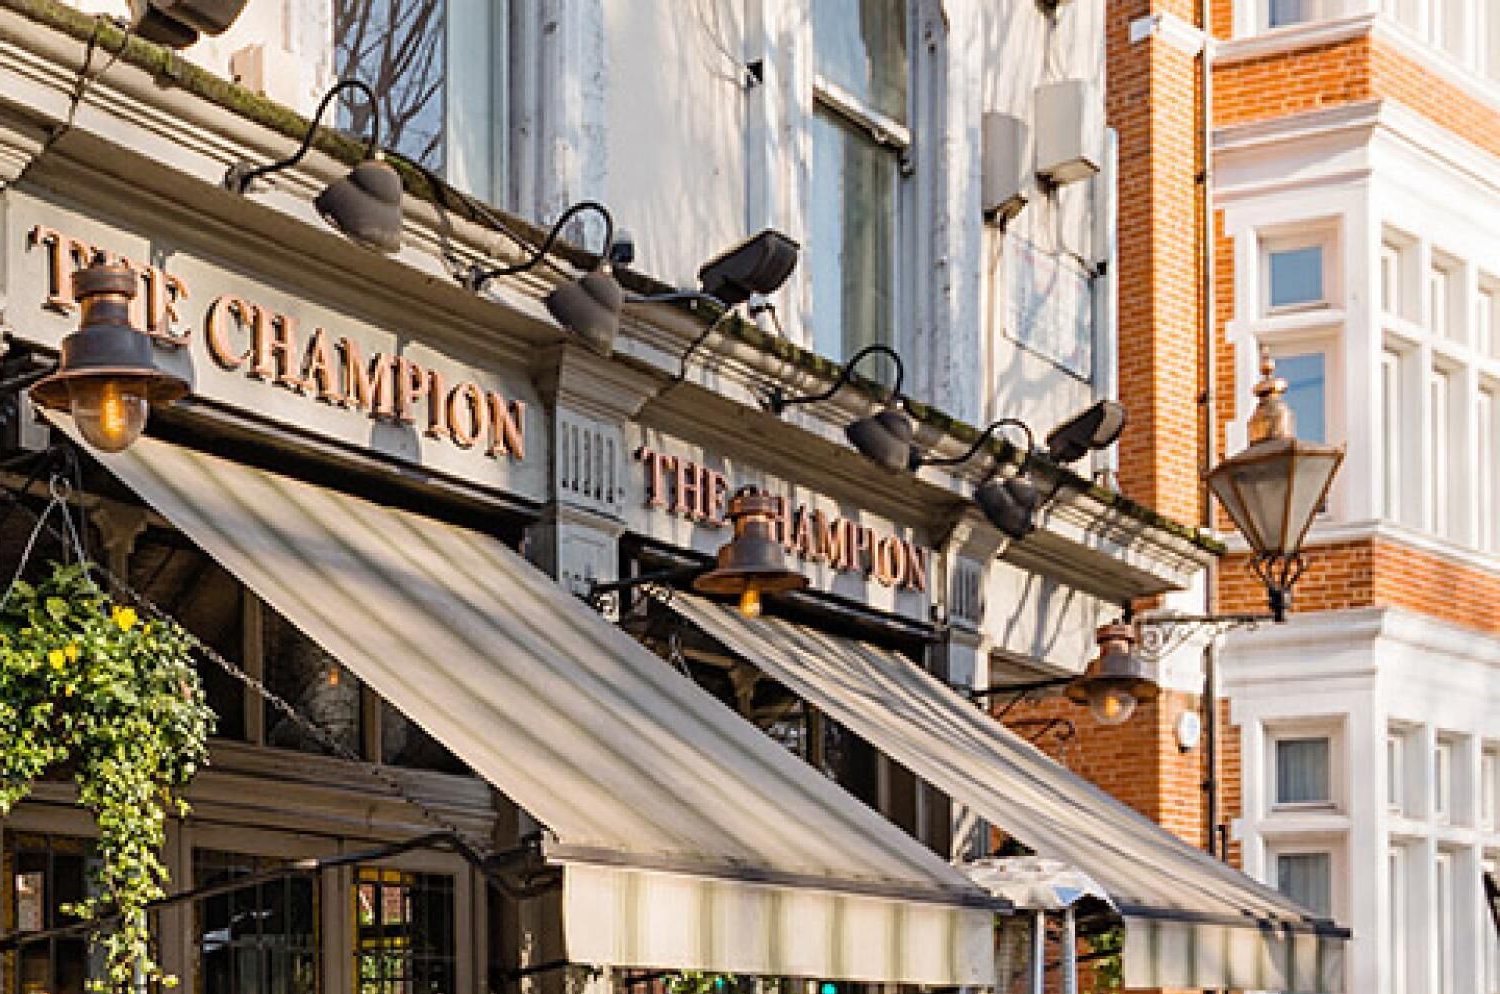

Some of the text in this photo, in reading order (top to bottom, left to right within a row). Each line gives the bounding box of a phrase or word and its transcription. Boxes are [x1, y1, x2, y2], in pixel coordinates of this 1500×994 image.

[205, 294, 526, 461] CHAMPION
[634, 446, 928, 592] THE HAMPION
